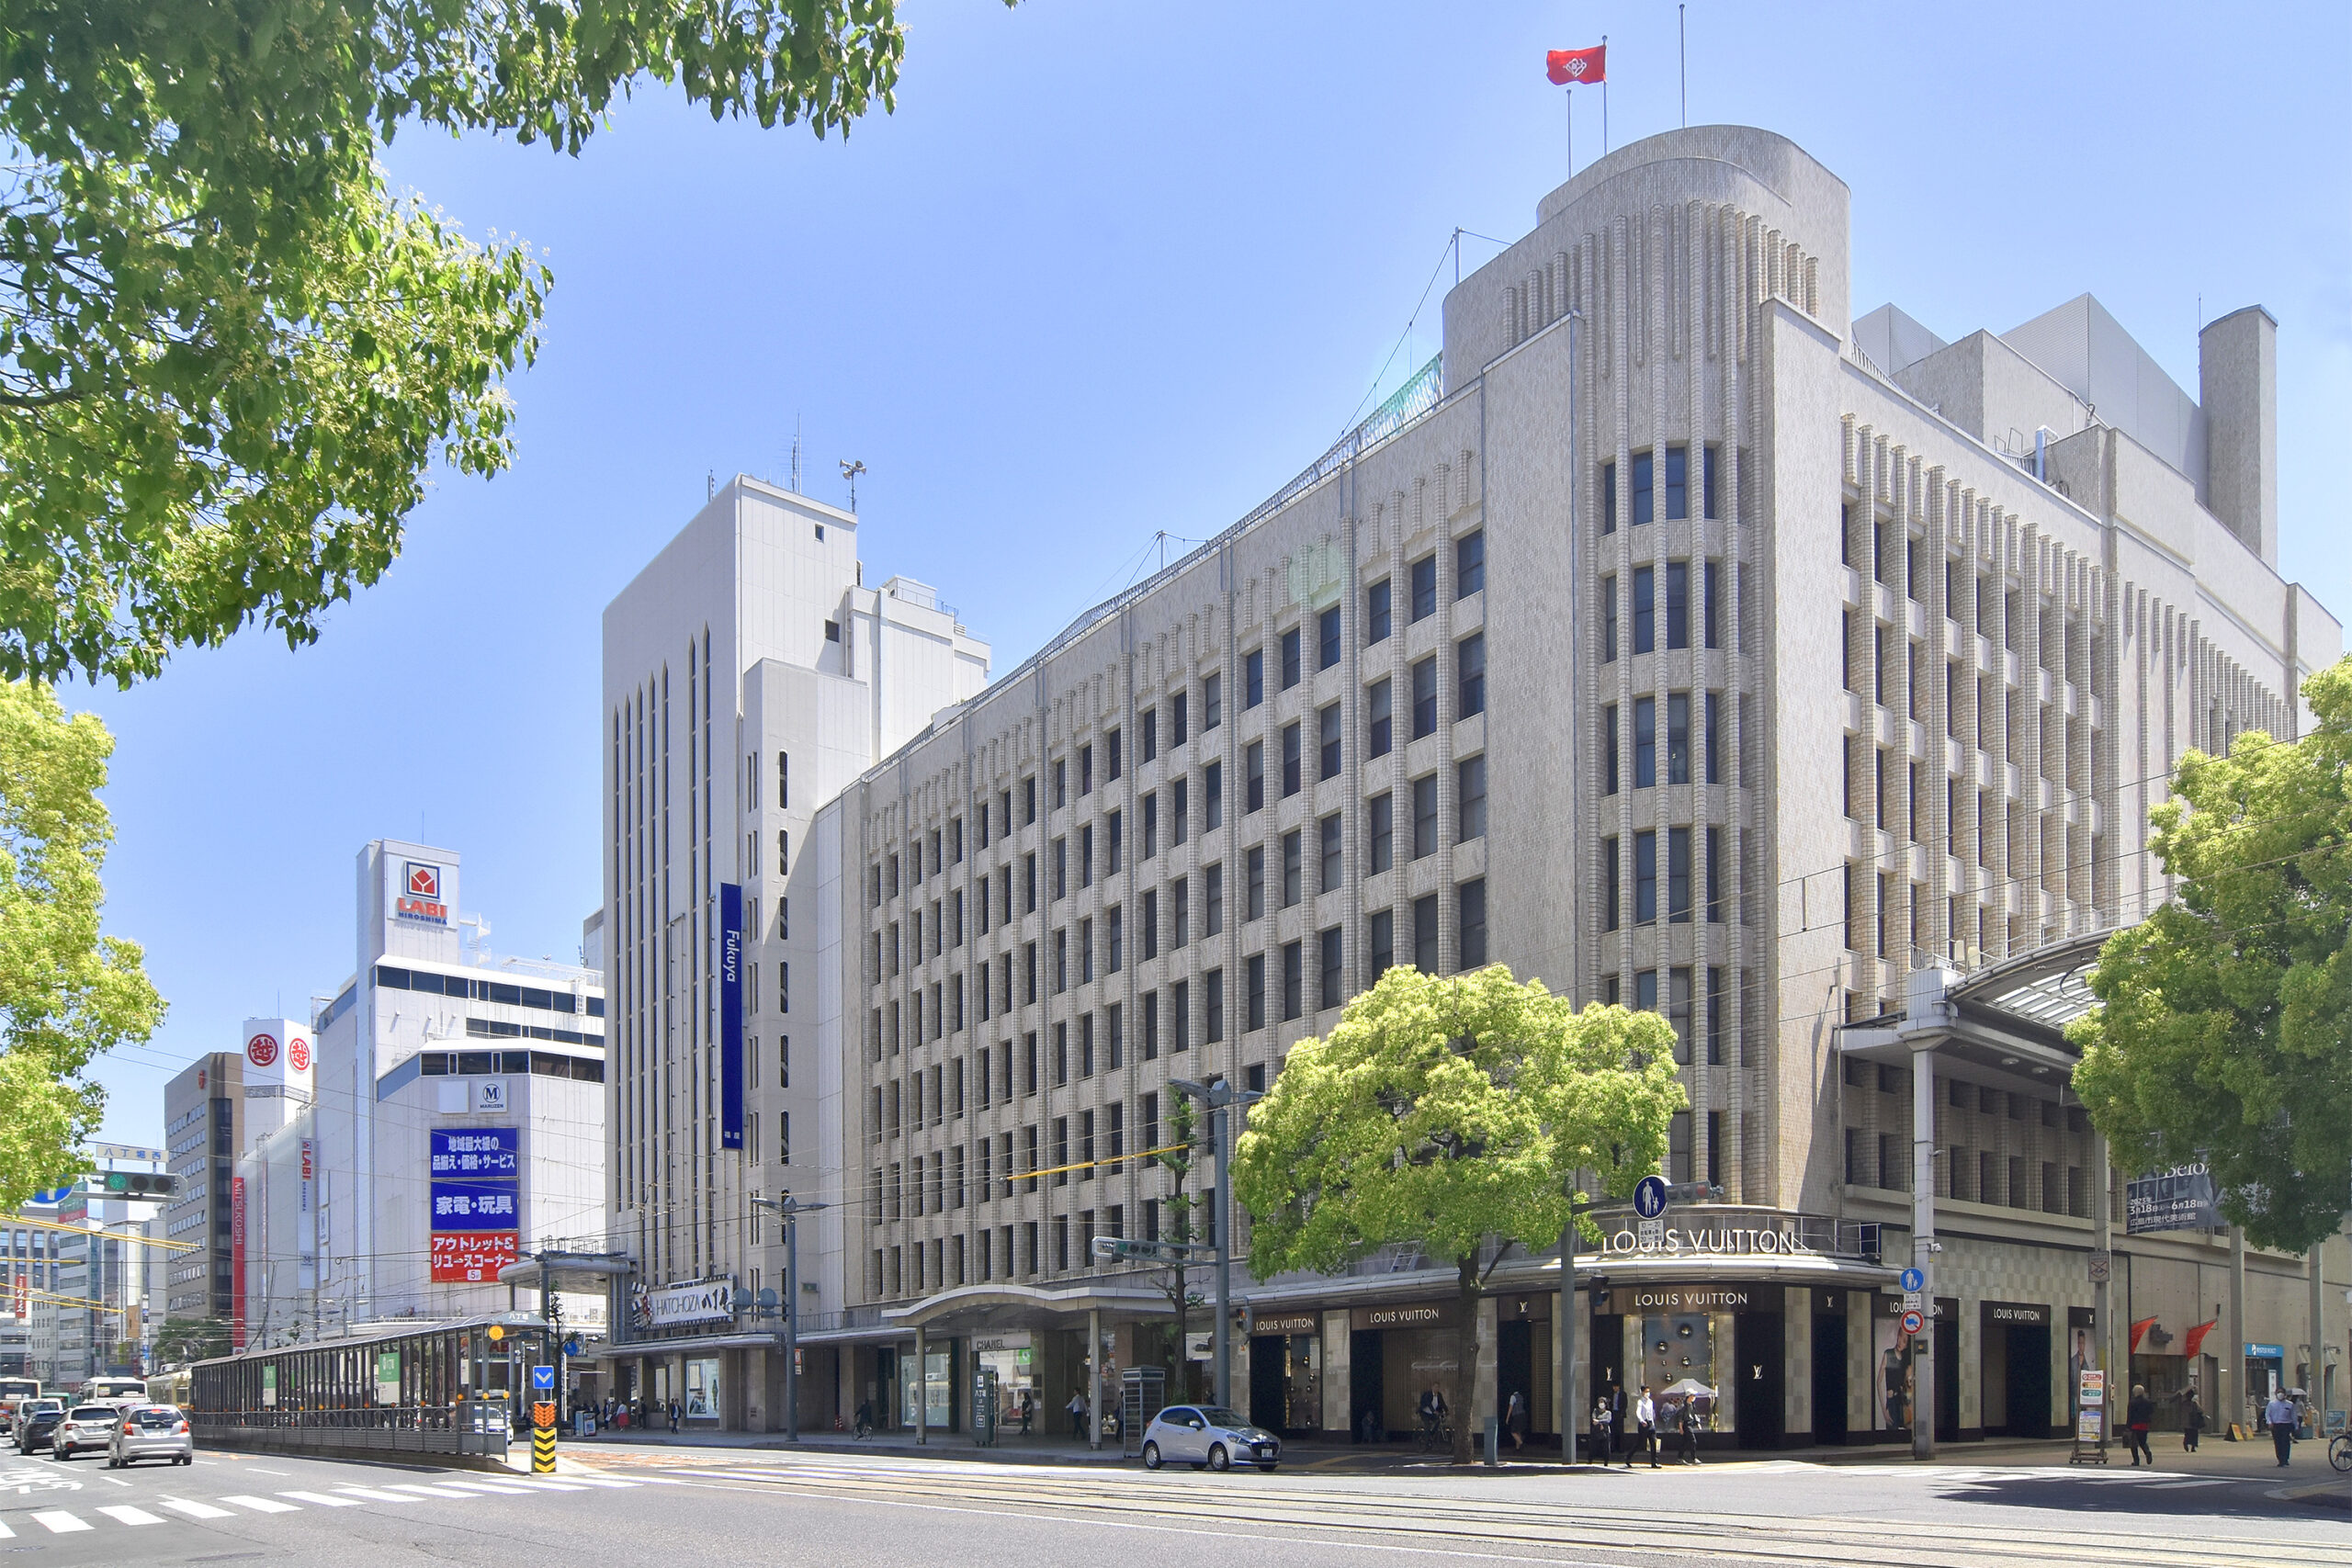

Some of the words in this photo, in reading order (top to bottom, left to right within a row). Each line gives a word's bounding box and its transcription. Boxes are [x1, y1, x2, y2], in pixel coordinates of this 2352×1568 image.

[398, 897, 447, 919] LABI
[399, 911, 447, 926] HIROSHIMA
[723, 930, 740, 982] Fukuya
[104, 1147, 161, 1160] 八丁堀西
[302, 1150, 311, 1180] LABI
[234, 1181, 243, 1245] MITSUKOSHI
[435, 1196, 513, 1215] 家電・玩具
[433, 1236, 514, 1251] アウトレット&
[1688, 1228, 1794, 1255] VUITTON
[433, 1254, 514, 1269] リユースコーナー
[656, 1293, 700, 1315] HATCHOZA
[1635, 1293, 1679, 1306] LOUIS
[1684, 1292, 1747, 1305] VUITTON
[1370, 1311, 1396, 1323] LOUIS
[1398, 1308, 1439, 1321] VUITTON
[1994, 1308, 2012, 1319] LOUIS
[2013, 1309, 2040, 1321] VUITTON
[1256, 1320, 1278, 1330] LOUIS
[1280, 1317, 1314, 1329] VUITTON
[977, 1339, 1005, 1350] CHANEL
